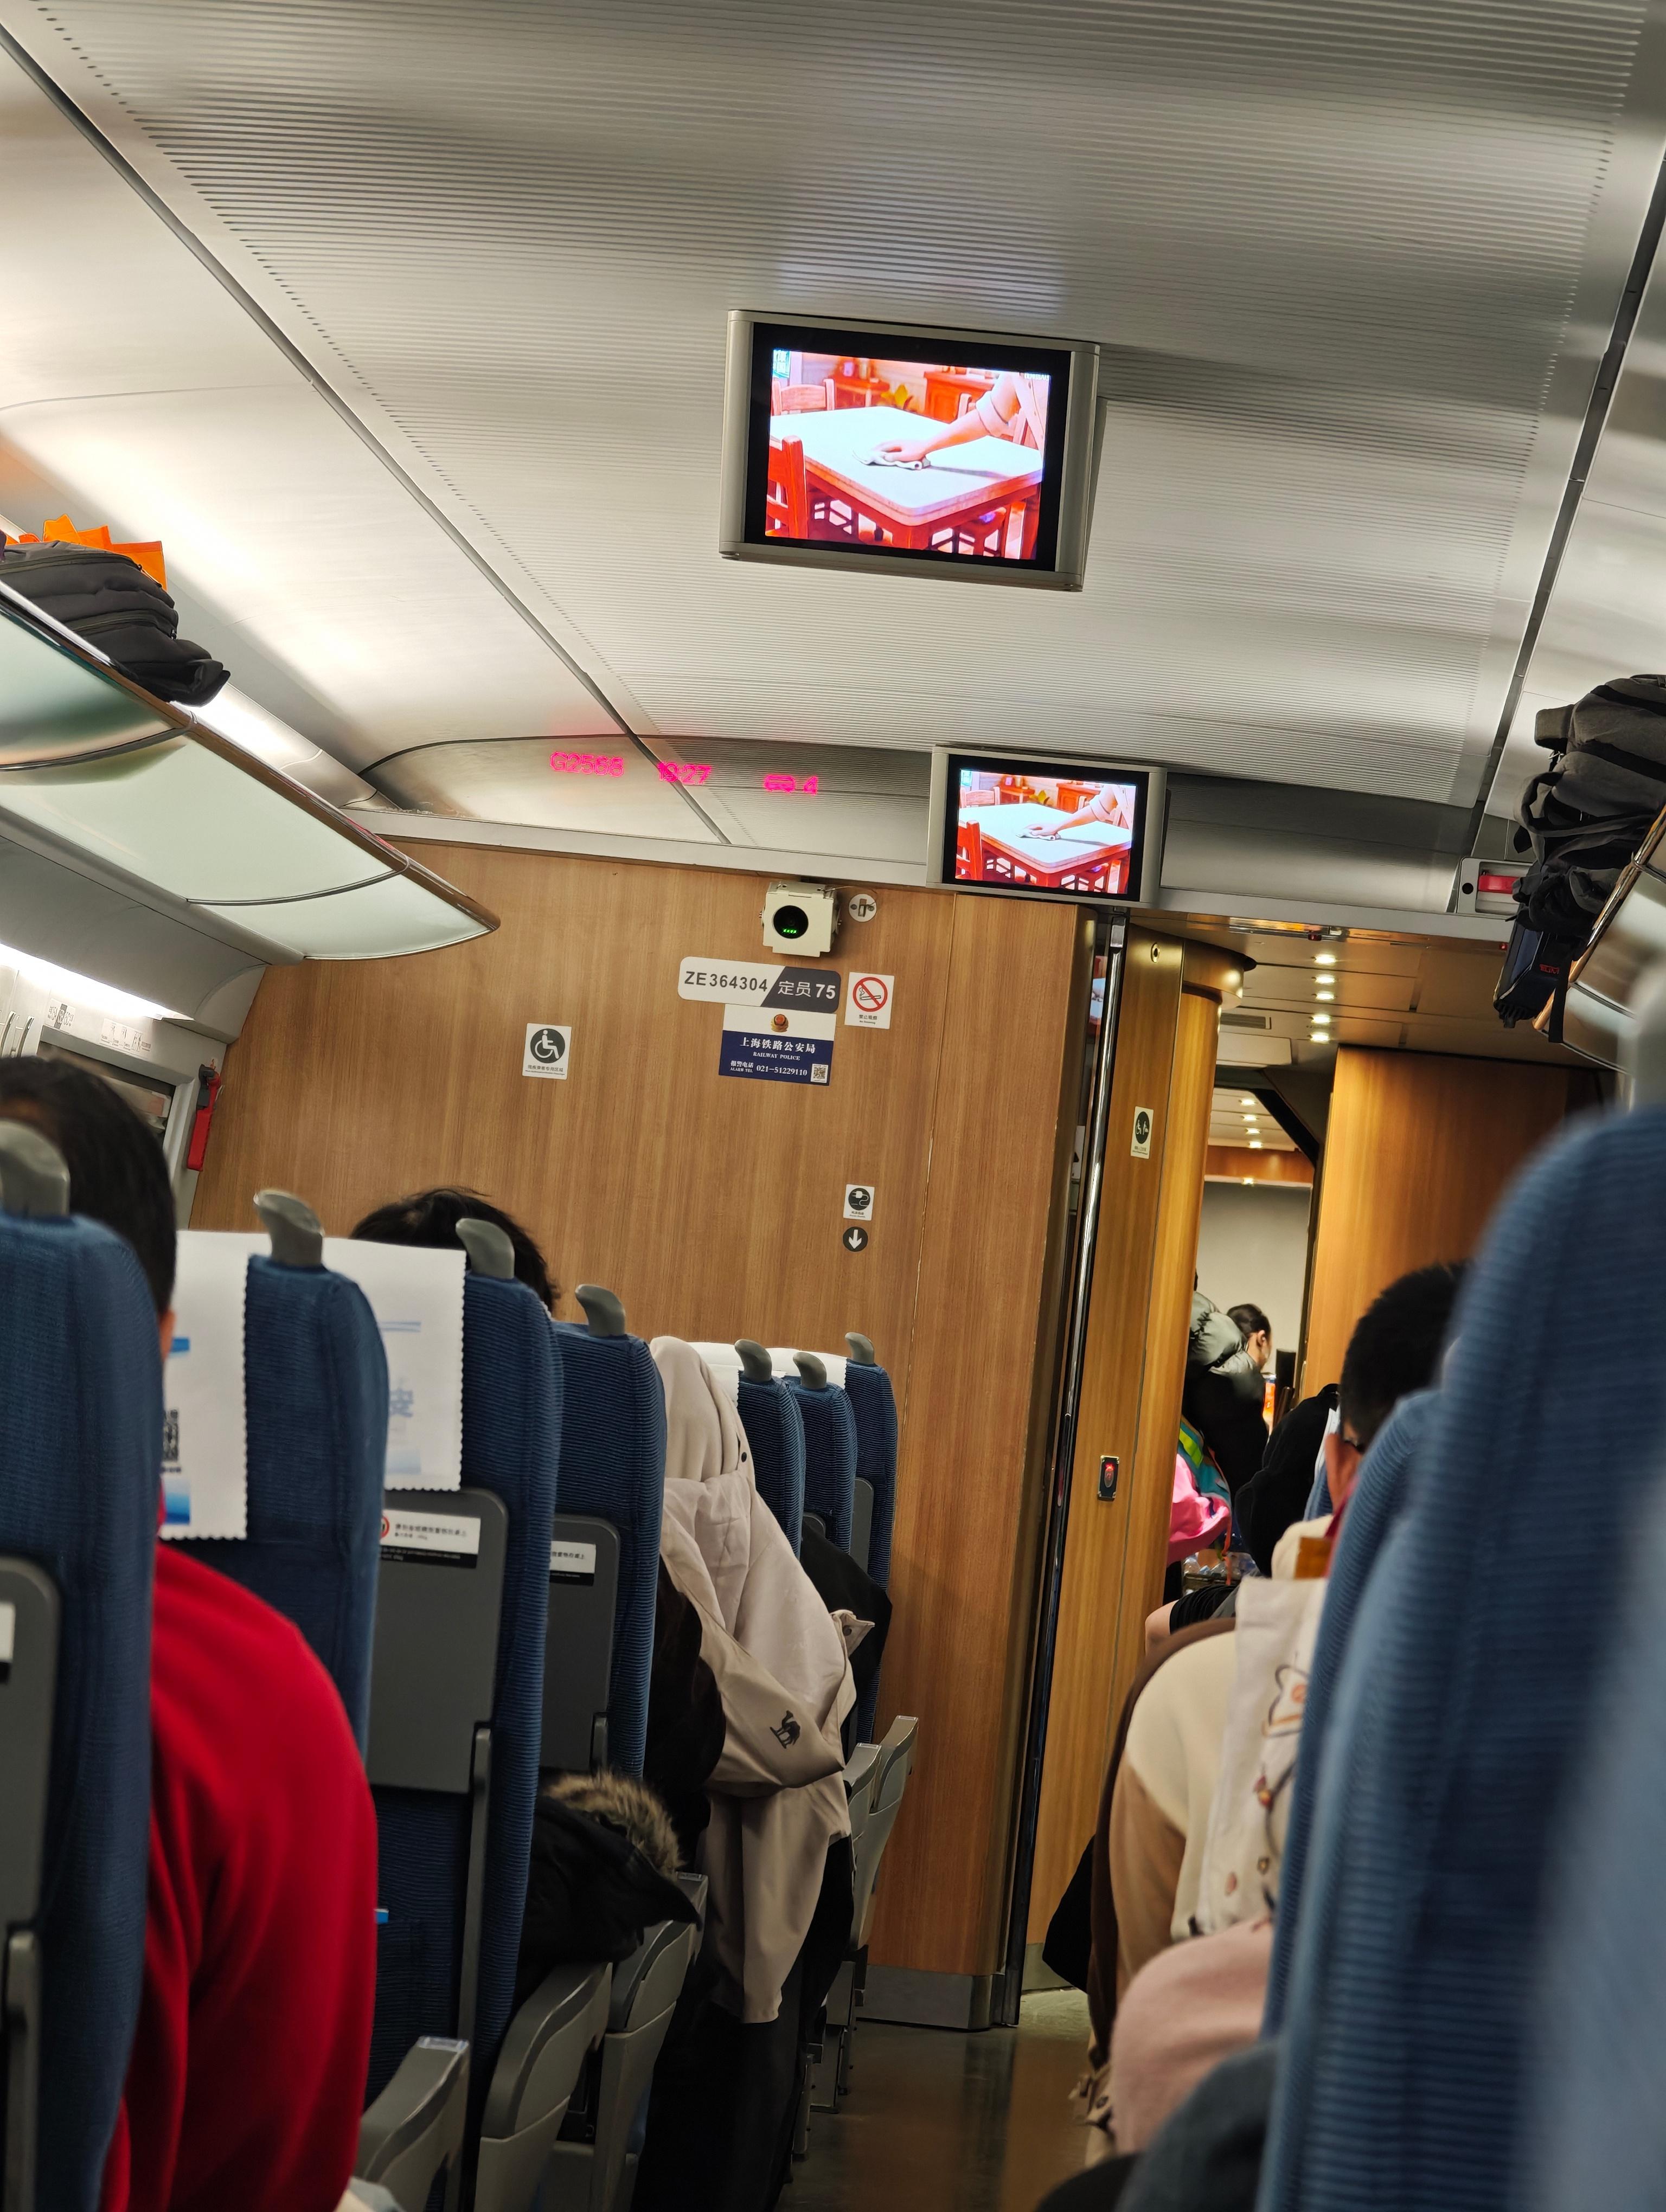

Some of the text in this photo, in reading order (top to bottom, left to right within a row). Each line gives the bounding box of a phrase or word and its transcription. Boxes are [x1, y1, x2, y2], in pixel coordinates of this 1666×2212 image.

[550, 751, 624, 778] G2568
[804, 775, 818, 796] 4
[684, 970, 768, 992] ZE364304
[740, 1037, 816, 1054] 上海铁路公安局
[731, 1060, 754, 1068] 报警电话
